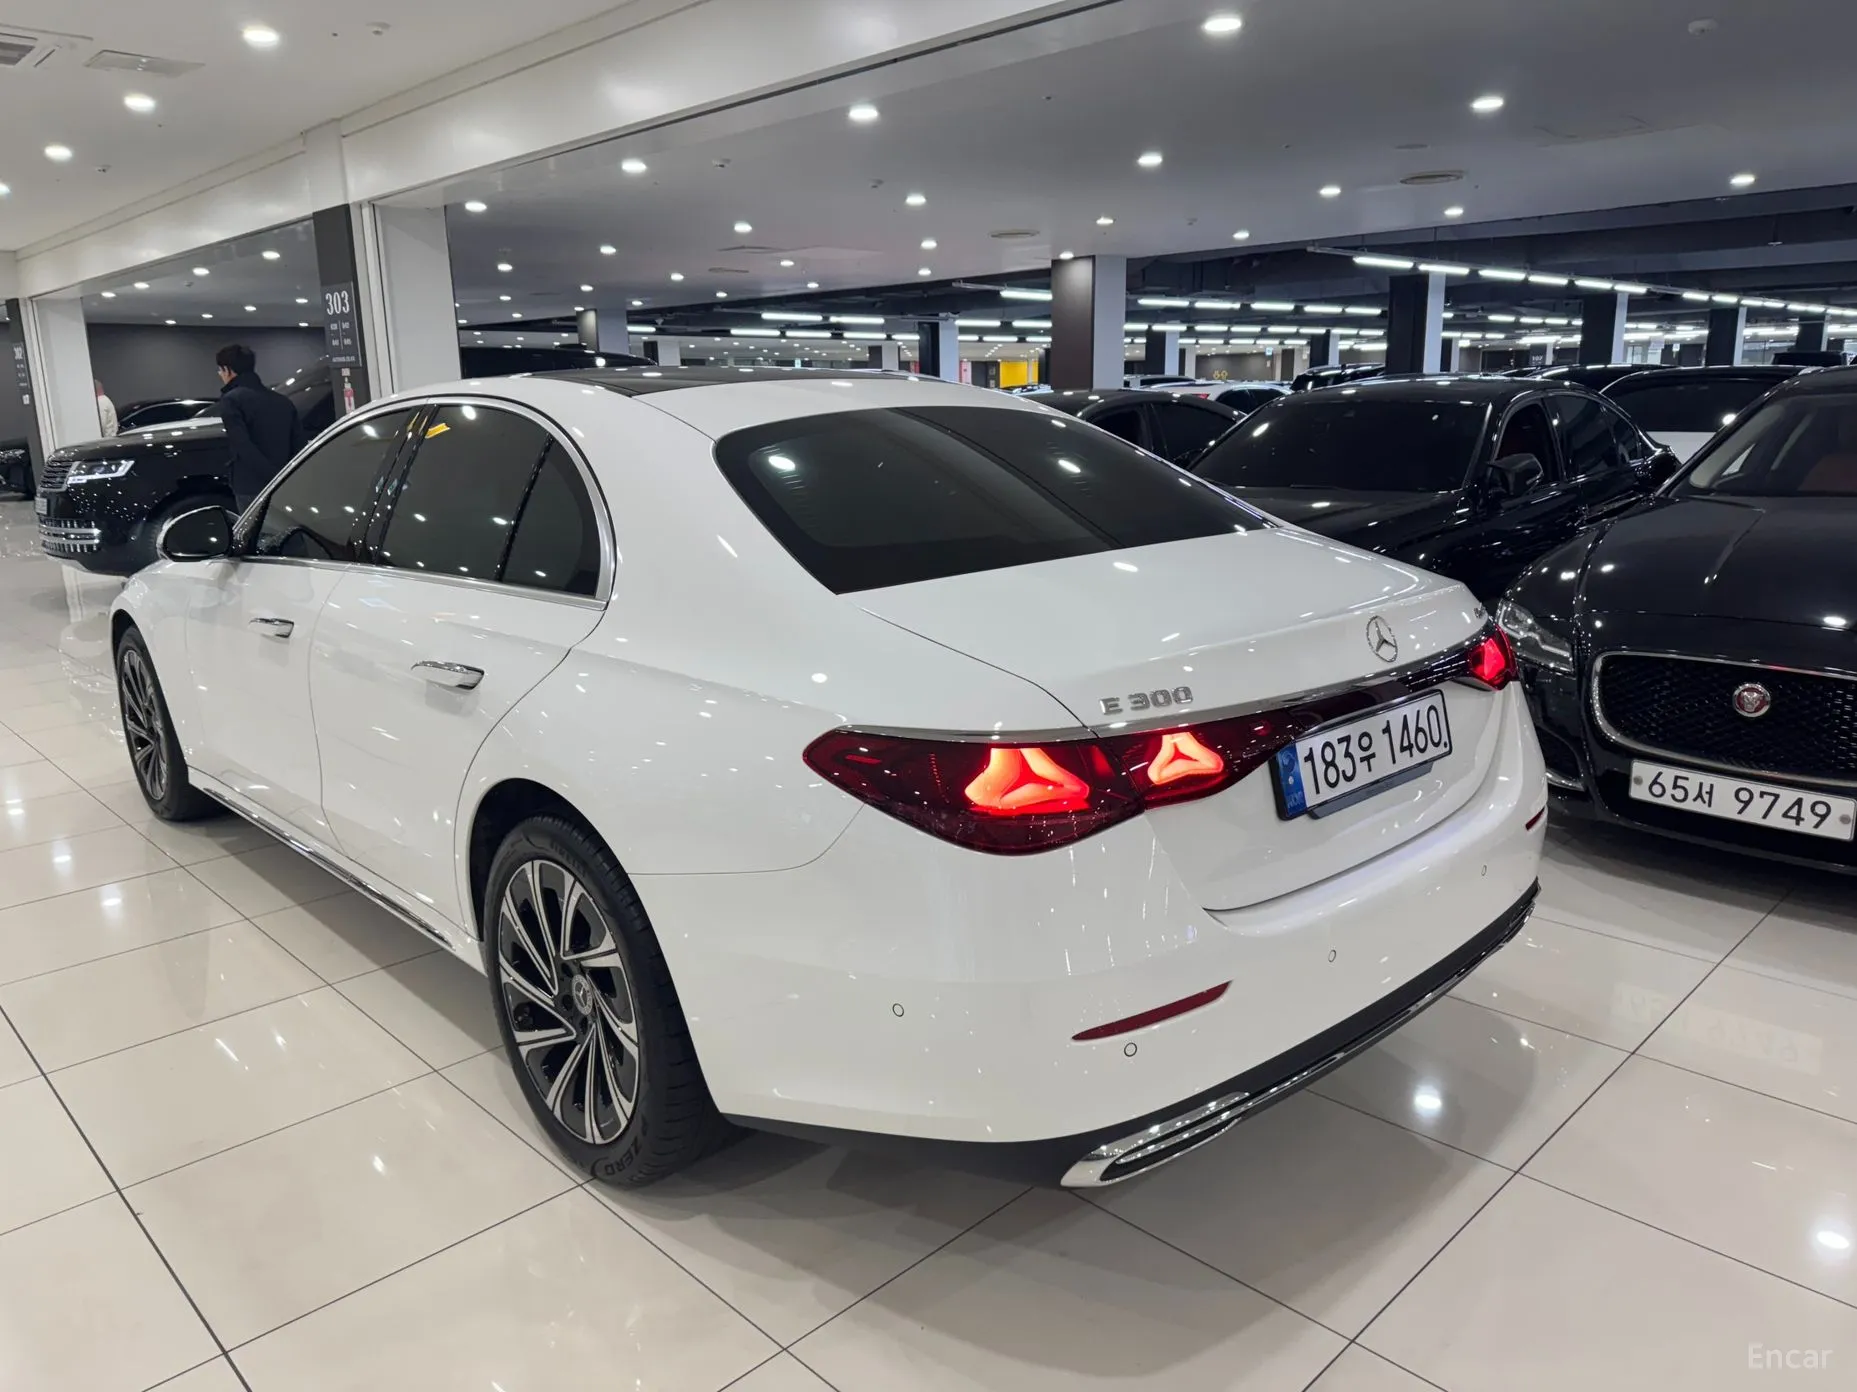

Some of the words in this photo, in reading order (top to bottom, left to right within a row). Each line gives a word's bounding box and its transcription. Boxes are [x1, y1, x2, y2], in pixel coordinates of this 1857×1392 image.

[325, 290, 350, 315] 303
[1100, 697, 1123, 715] E
[1128, 686, 1194, 711] 300
[1304, 731, 1376, 795] 183우
[1382, 704, 1442, 764] 1460
[1648, 771, 1715, 808] 65서
[1734, 787, 1832, 829] 9749
